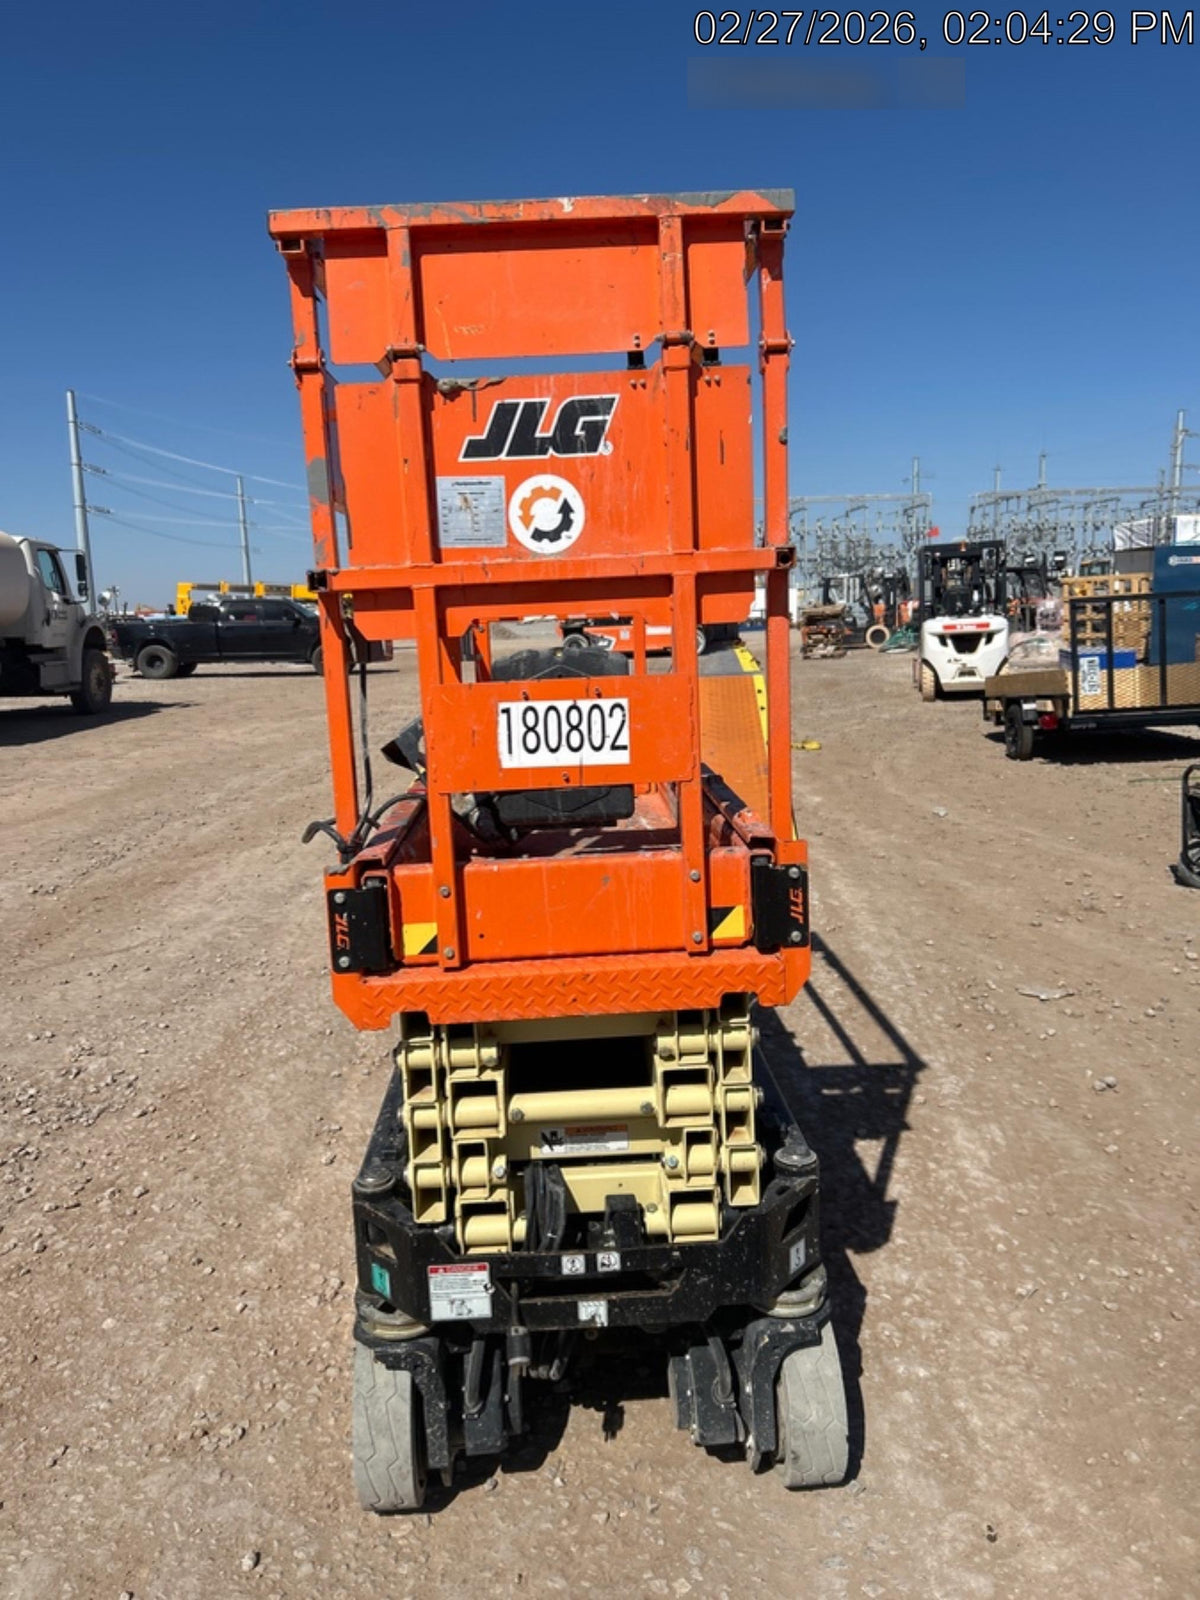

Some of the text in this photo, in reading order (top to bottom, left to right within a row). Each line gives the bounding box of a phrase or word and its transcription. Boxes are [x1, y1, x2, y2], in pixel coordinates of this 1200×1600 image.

[461, 395, 619, 460] JLG
[501, 703, 628, 755] 180802
[789, 886, 804, 925] JLG
[335, 912, 350, 950] JLG
